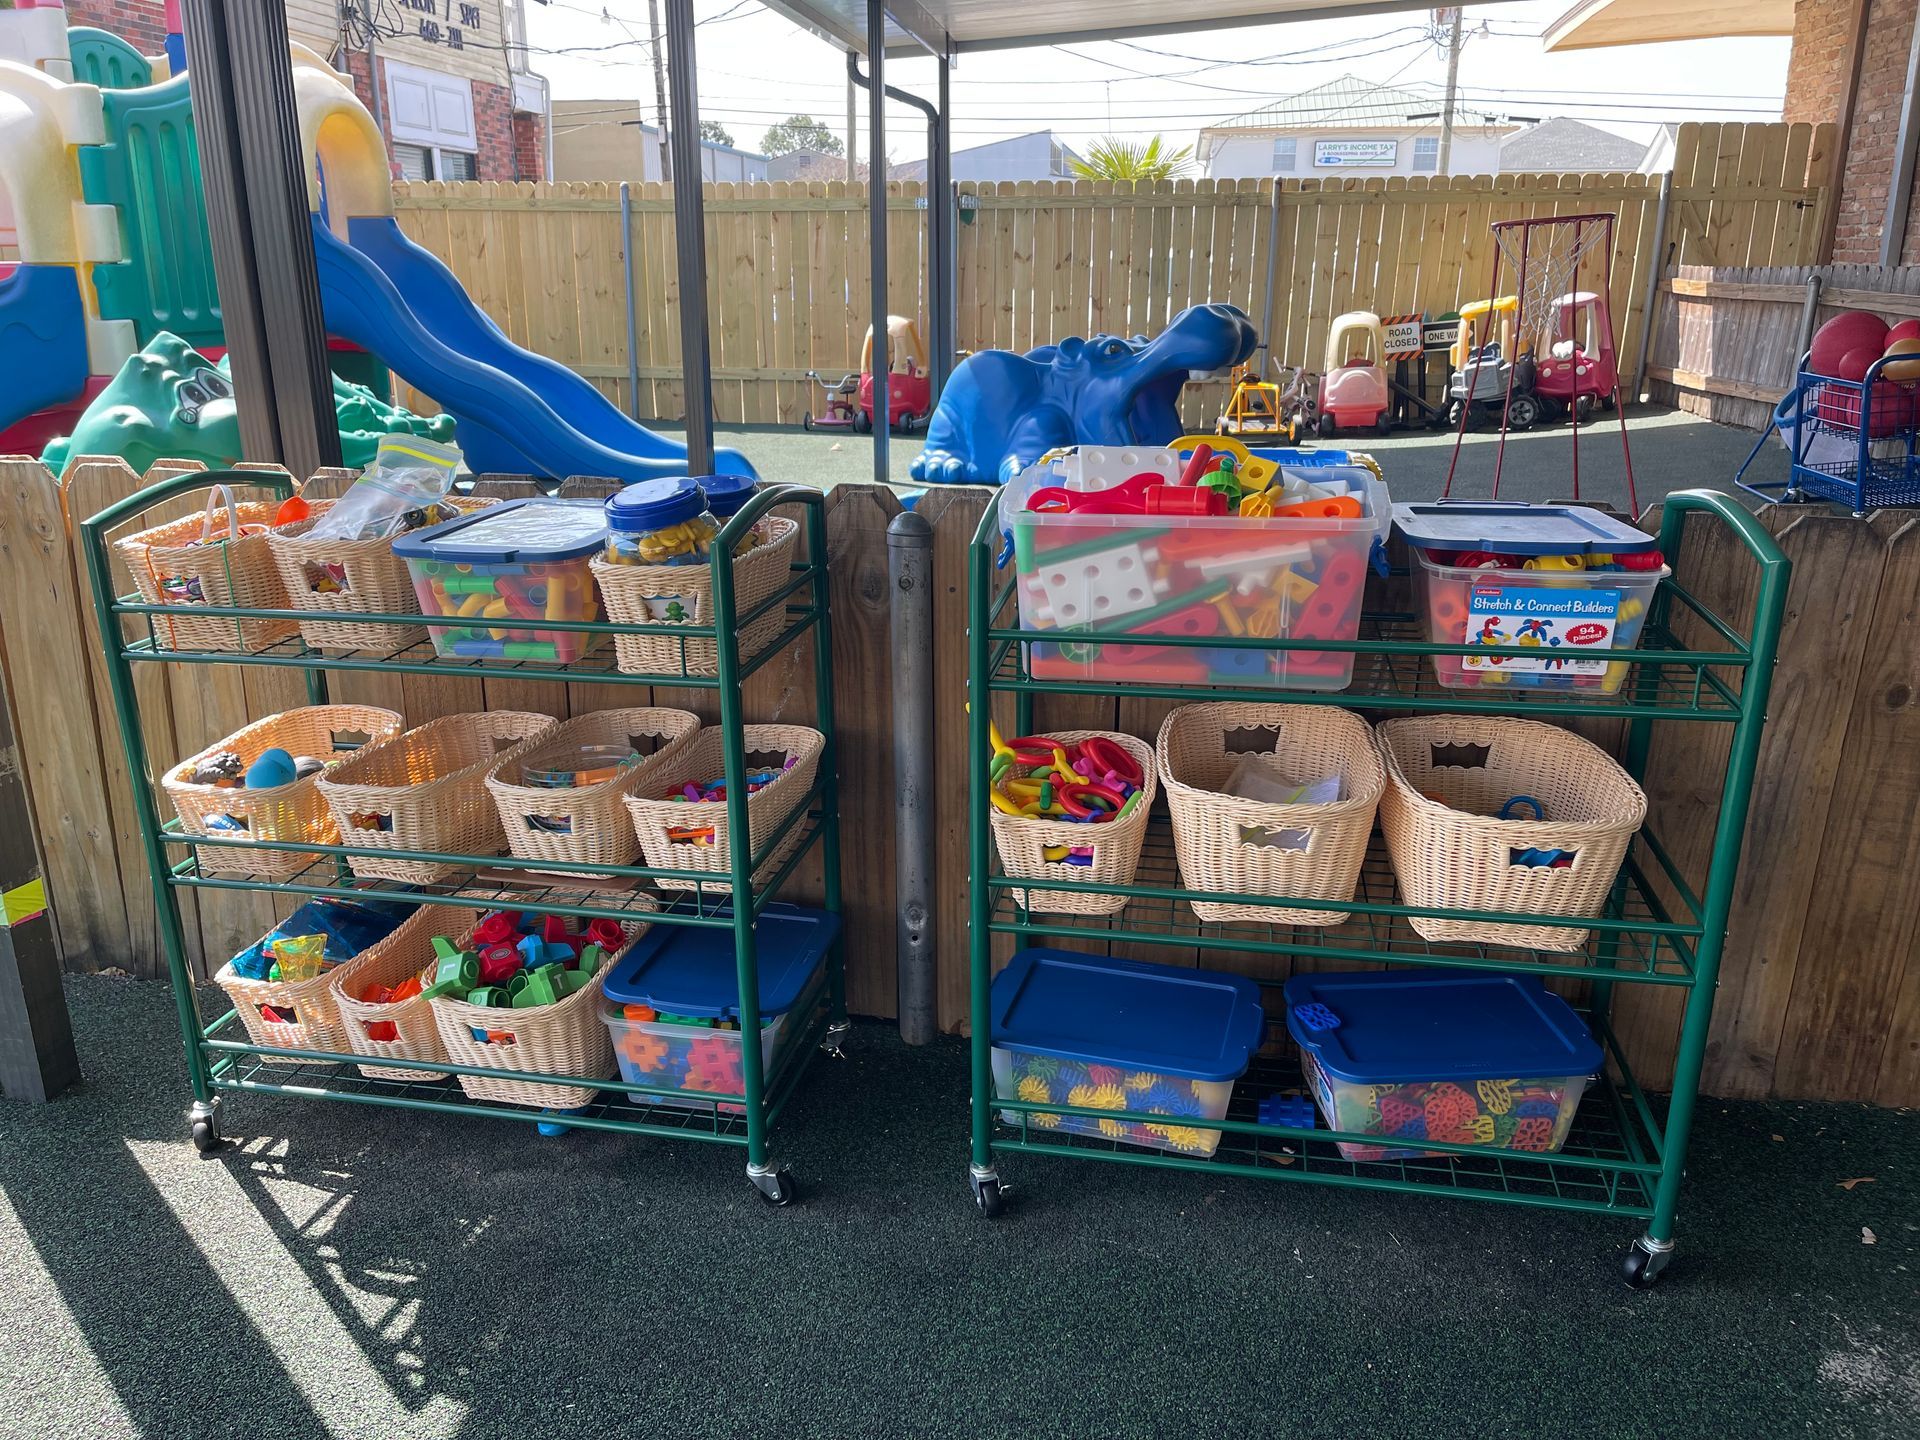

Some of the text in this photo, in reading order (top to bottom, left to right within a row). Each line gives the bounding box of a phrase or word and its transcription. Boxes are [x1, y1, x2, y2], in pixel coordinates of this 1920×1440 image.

[459, 3, 480, 29] SPA
[1349, 143, 1378, 151] INCOME
[1388, 327, 1412, 337] ROAD
[1428, 330, 1459, 341] ONE WA
[1384, 338, 1418, 349] CLOSED
[1474, 597, 1614, 614] Stretch & Connect Builders
[1573, 630, 1602, 642] pieces!
[1579, 626, 1595, 635] 94
